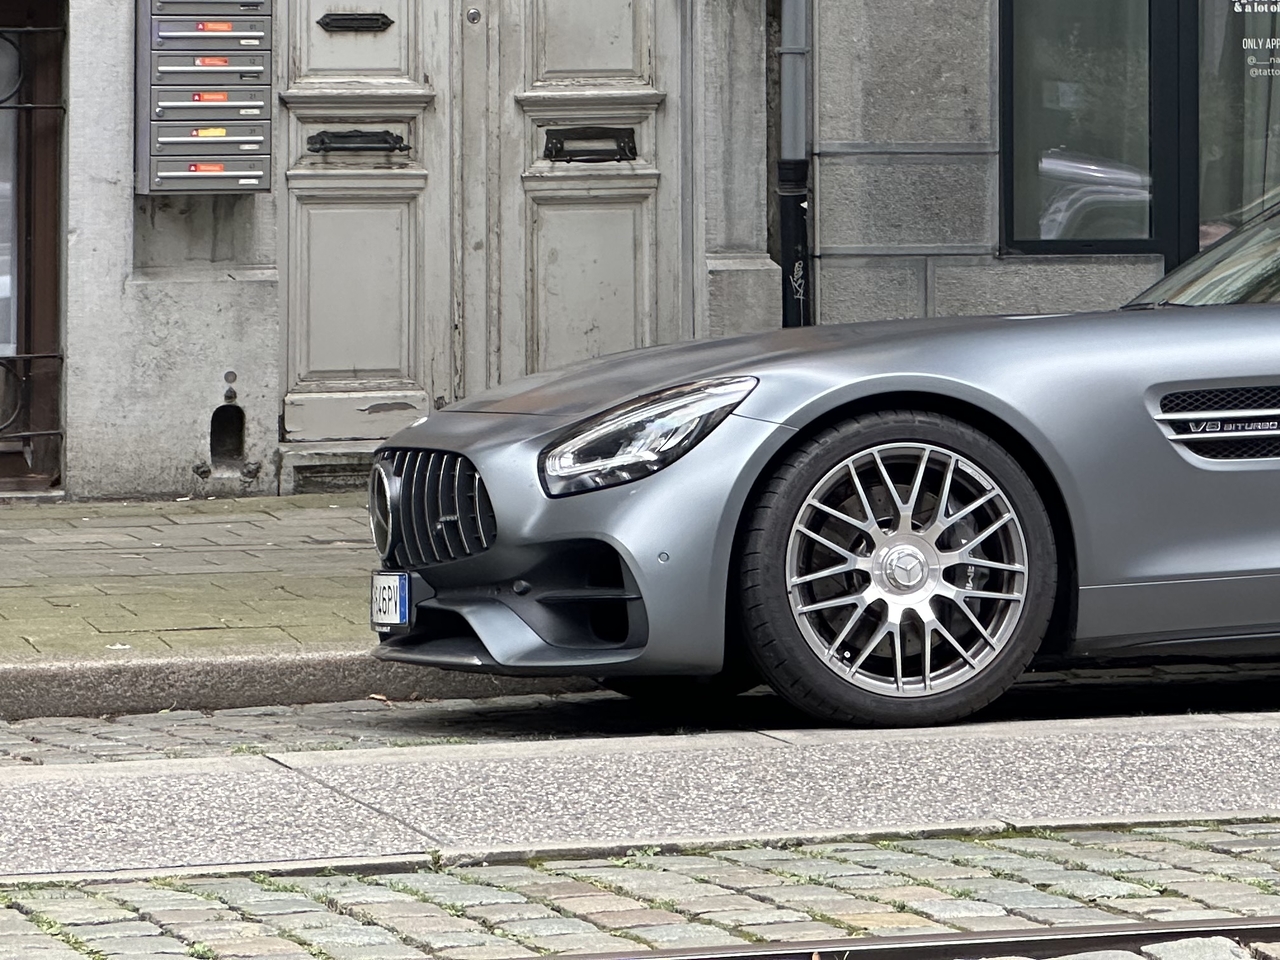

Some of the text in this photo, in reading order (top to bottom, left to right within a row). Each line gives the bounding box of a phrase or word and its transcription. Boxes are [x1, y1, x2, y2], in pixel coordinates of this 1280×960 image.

[1233, 2, 1242, 13] &
[1245, 4, 1252, 13] a
[1254, 2, 1268, 13] lot
[1242, 38, 1263, 49] ONLY
[1189, 421, 1278, 432] V8 BITURBO
